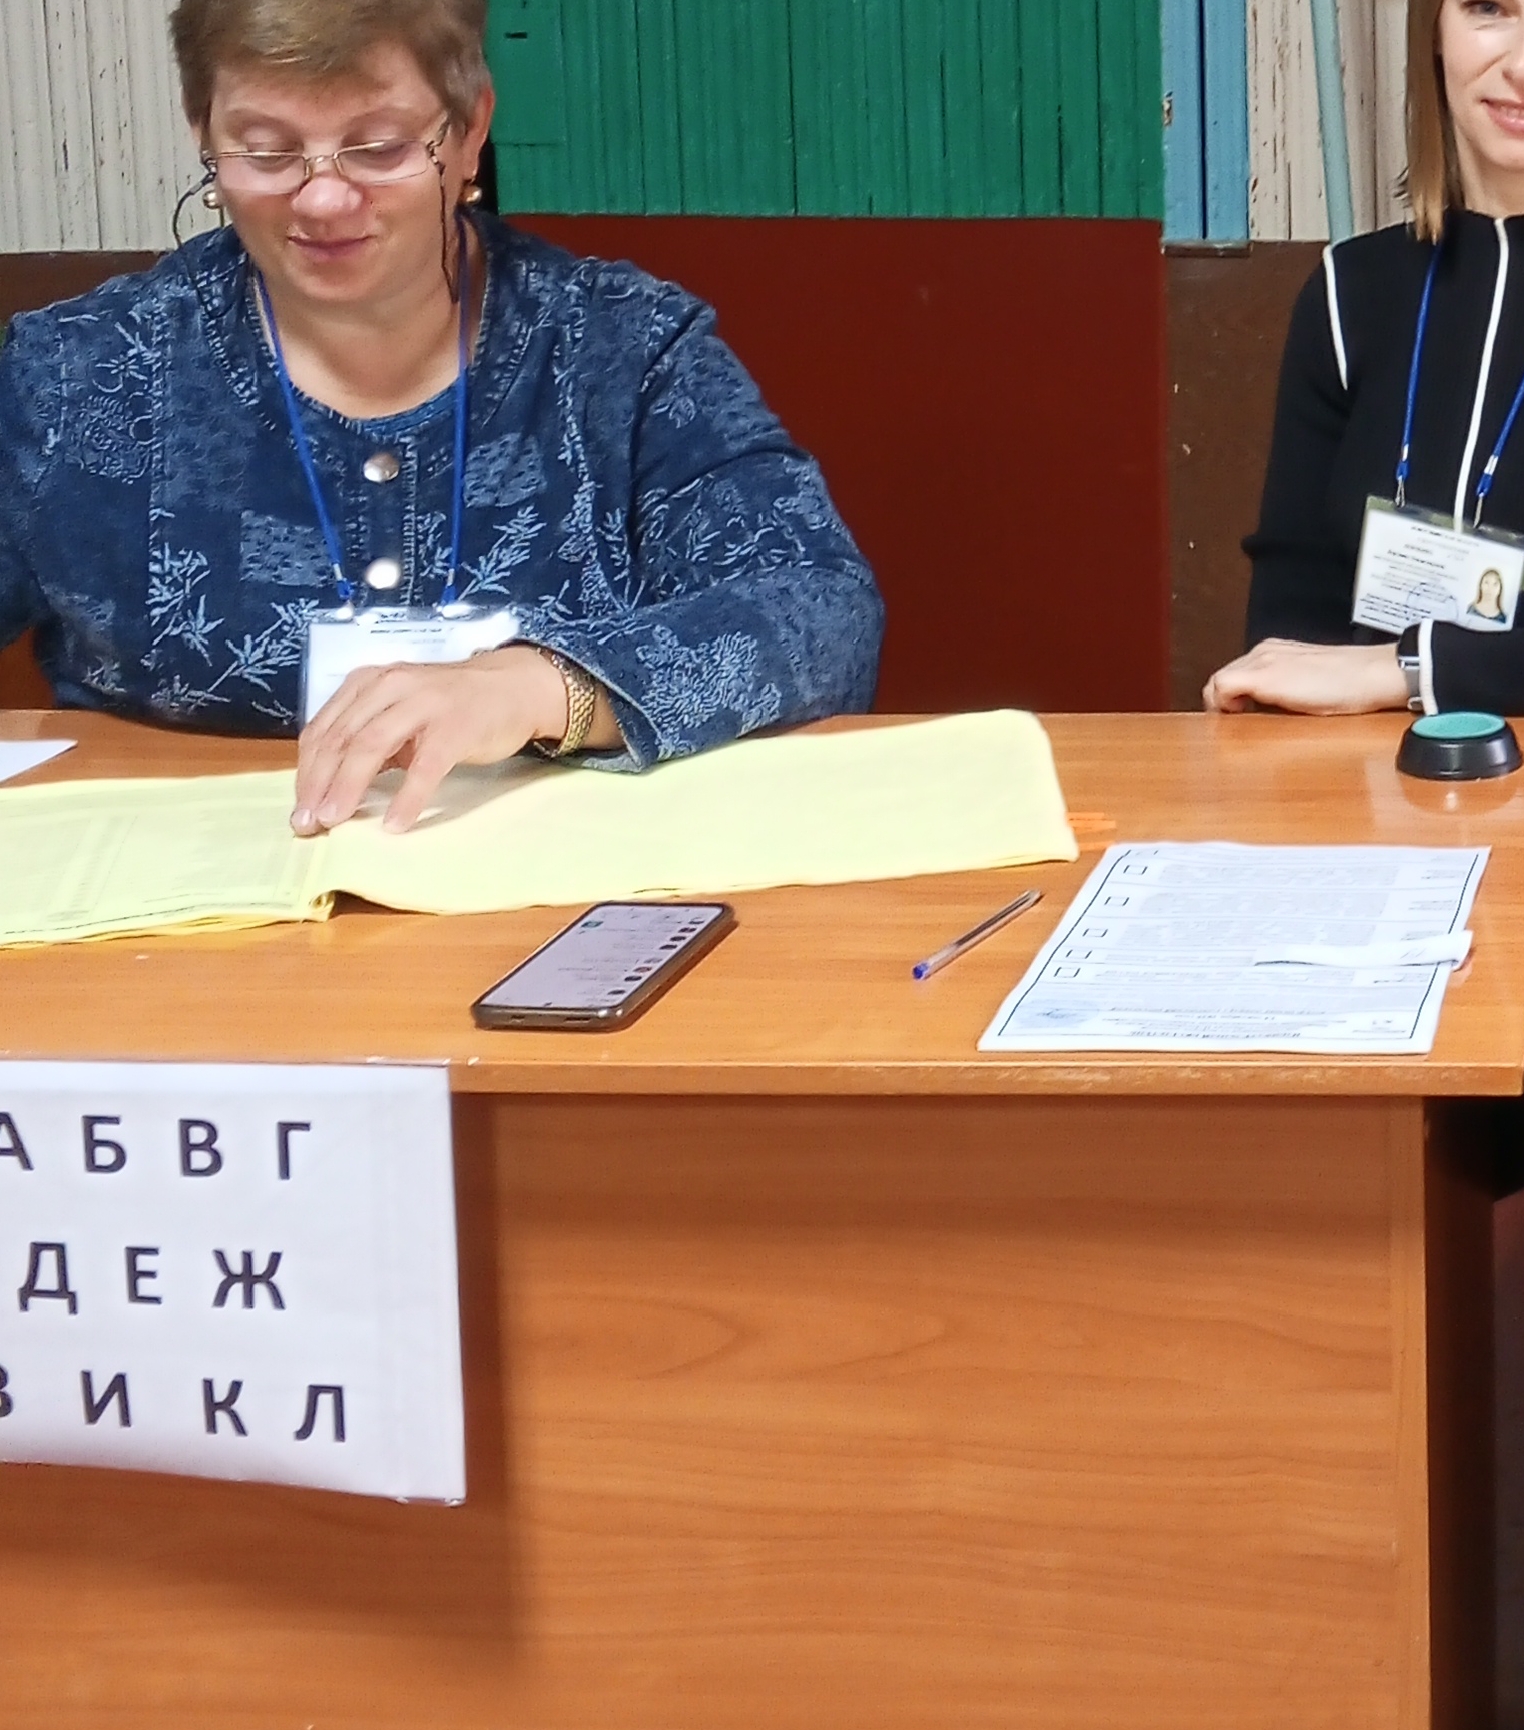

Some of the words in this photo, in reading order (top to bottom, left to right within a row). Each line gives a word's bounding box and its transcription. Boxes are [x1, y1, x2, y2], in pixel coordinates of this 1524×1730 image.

[82, 1115, 126, 1173] Б
[179, 1119, 222, 1177] В
[278, 1122, 311, 1179] Г
[19, 1242, 78, 1314] Д
[125, 1246, 161, 1304] Е
[214, 1250, 285, 1309] Ж
[81, 1371, 131, 1427] И
[203, 1379, 247, 1436] К
[295, 1384, 345, 1442] Л
